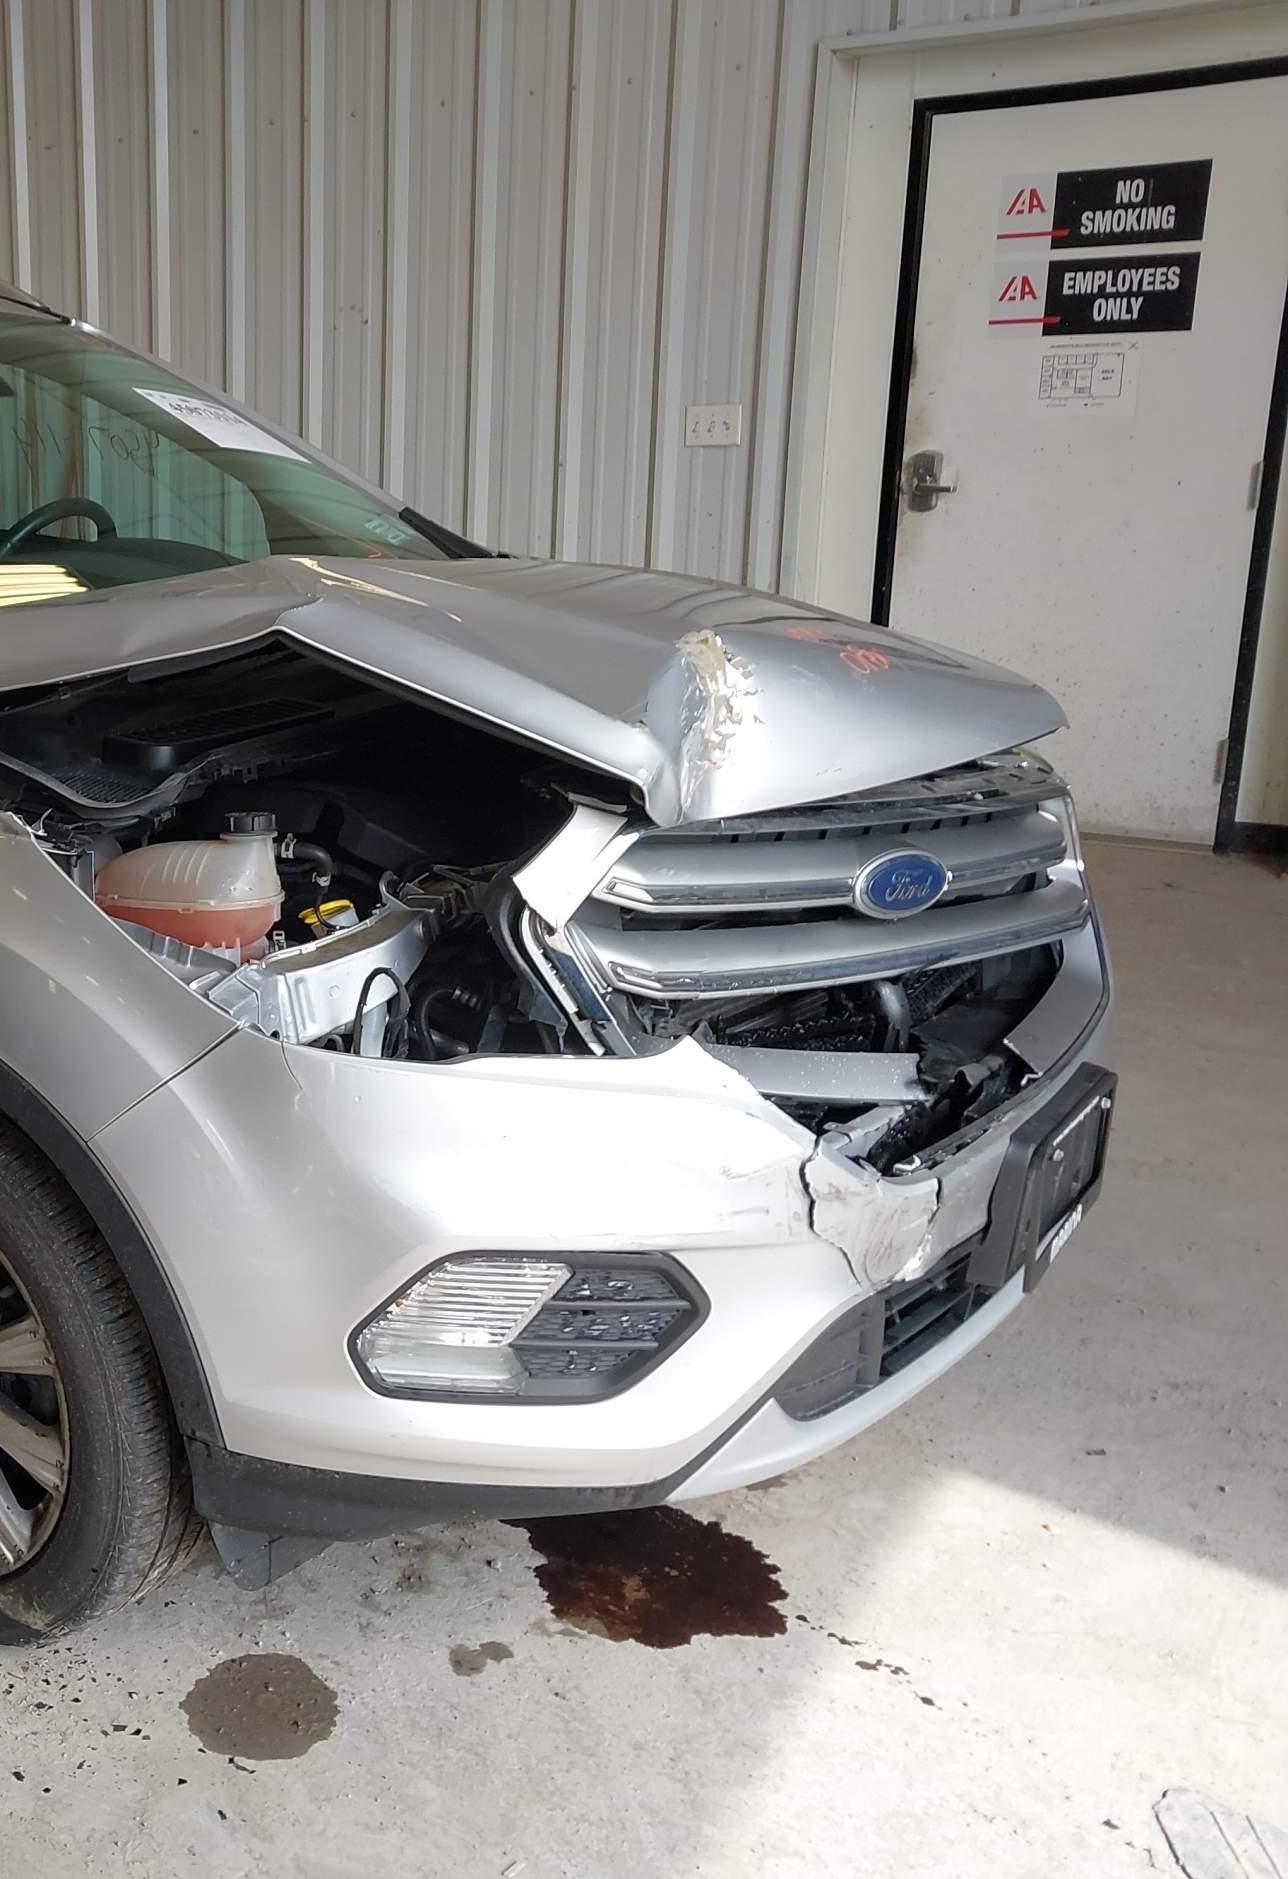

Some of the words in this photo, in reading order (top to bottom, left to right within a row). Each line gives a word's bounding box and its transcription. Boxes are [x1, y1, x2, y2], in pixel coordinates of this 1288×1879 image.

[1115, 178, 1145, 205] NO
[1080, 205, 1176, 236] SMOKING
[1062, 266, 1181, 295] EMPLOYEES
[1092, 296, 1144, 322] ONLY
[885, 869, 933, 903] Ford
